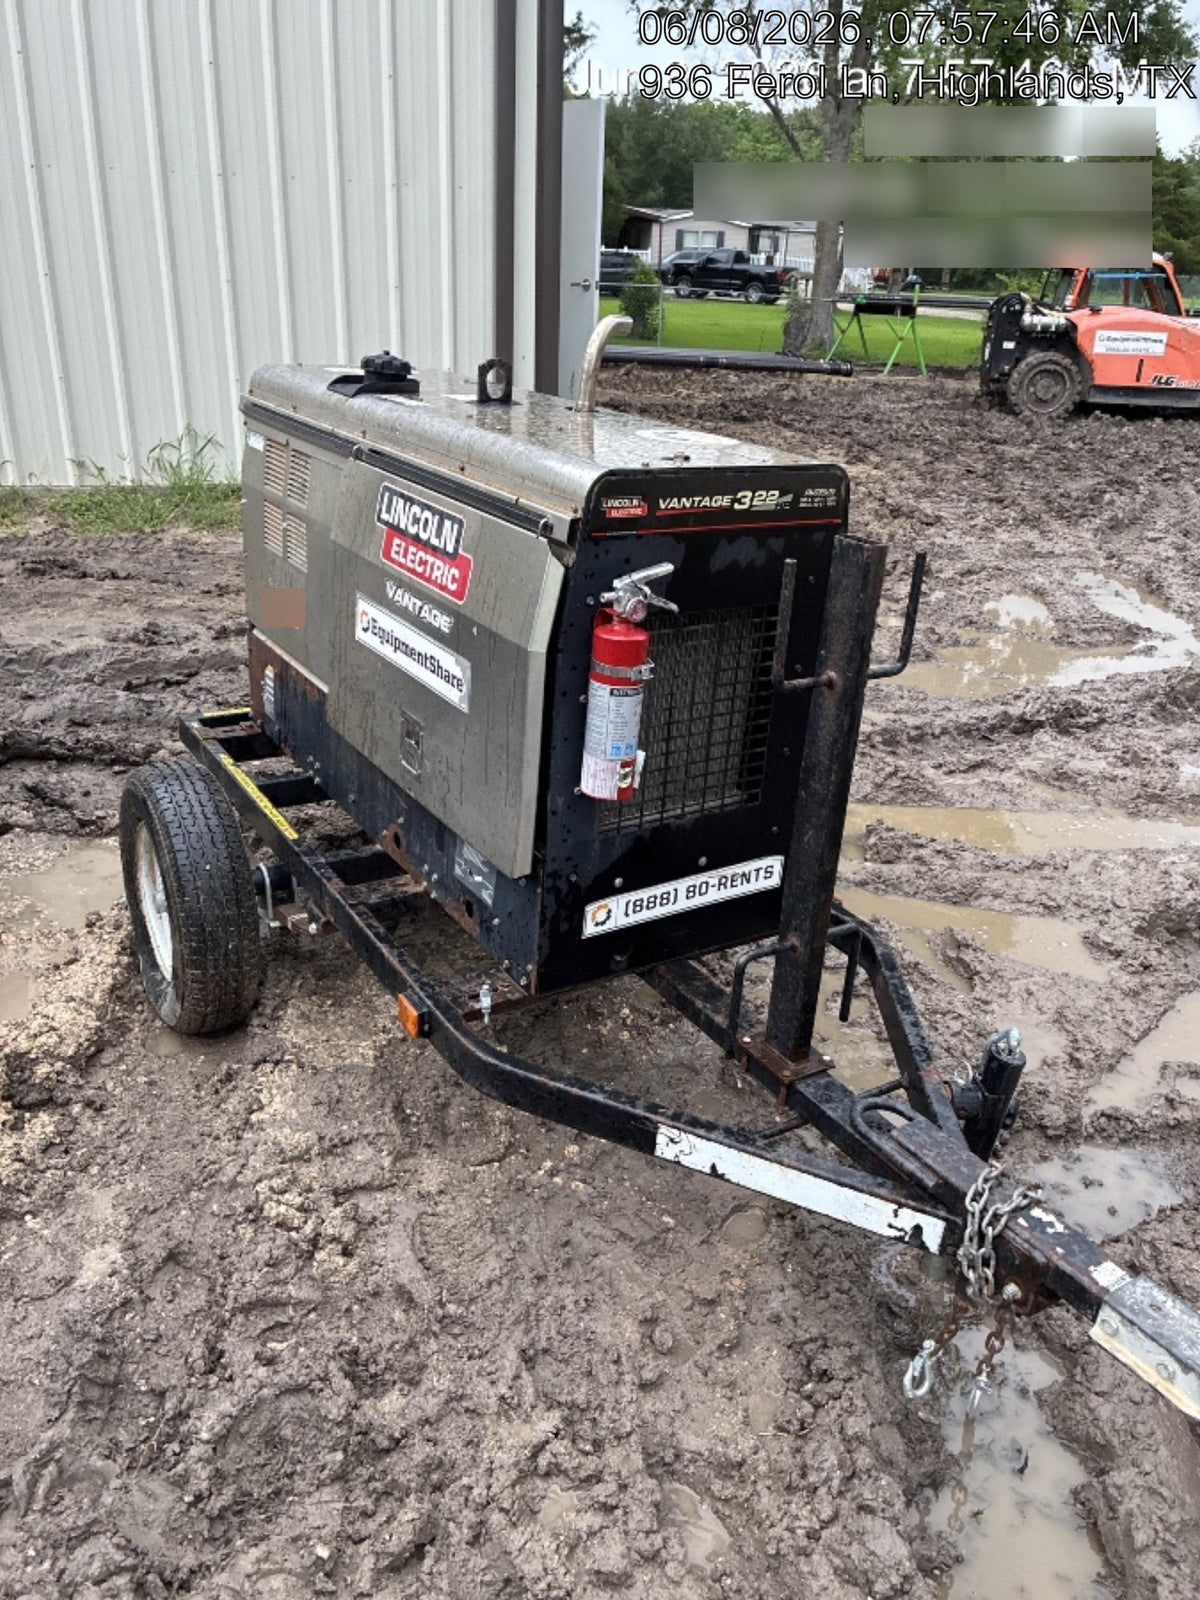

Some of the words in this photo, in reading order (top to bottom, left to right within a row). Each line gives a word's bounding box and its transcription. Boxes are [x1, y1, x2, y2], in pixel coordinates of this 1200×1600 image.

[380, 492, 459, 554] LINCOLN
[602, 498, 640, 508] LINCOLN
[659, 495, 735, 510] VANTAGE
[734, 489, 780, 510] 322
[390, 537, 459, 592] ELECTRIC
[385, 578, 455, 634] VANTAGE
[371, 616, 464, 694] EquipmentShare
[624, 887, 679, 918] (888)
[685, 864, 775, 901] 80-RENTS
